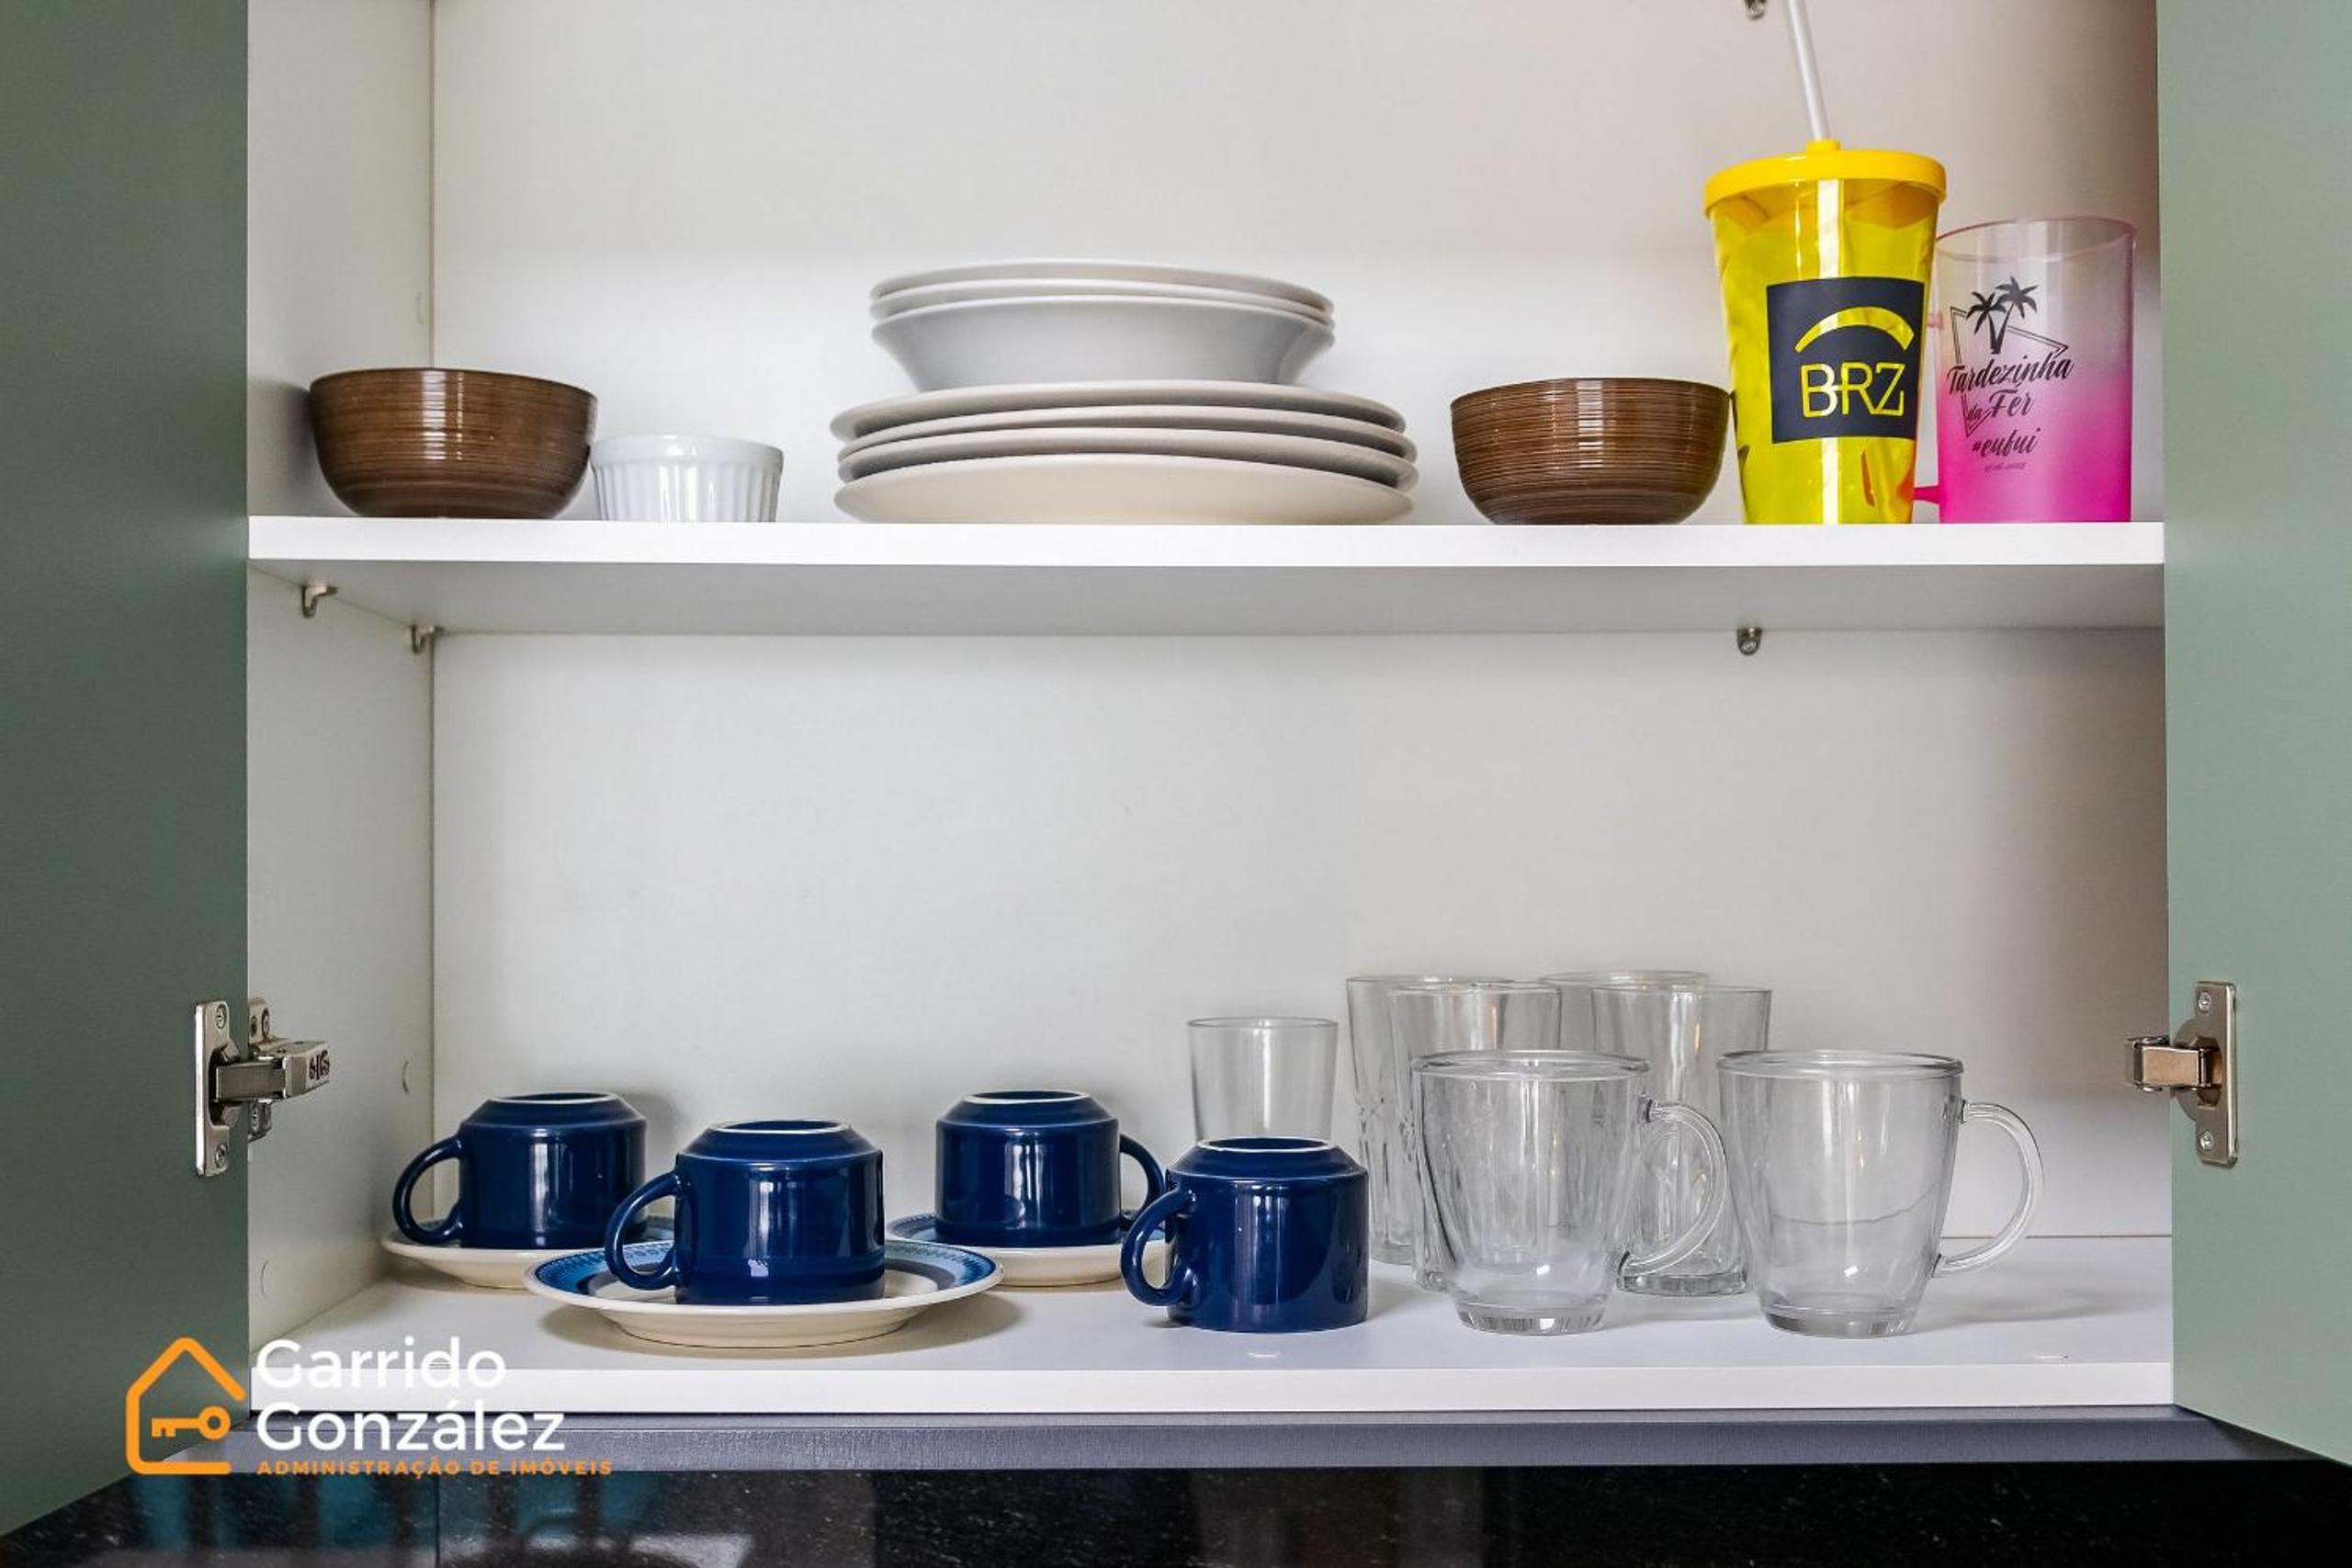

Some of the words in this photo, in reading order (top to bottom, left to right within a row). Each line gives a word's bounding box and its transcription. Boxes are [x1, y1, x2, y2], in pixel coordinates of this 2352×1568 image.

[1801, 362, 1905, 417] BRZ
[1947, 352, 2075, 394] Tardezinha
[1989, 389, 2033, 418] Fer
